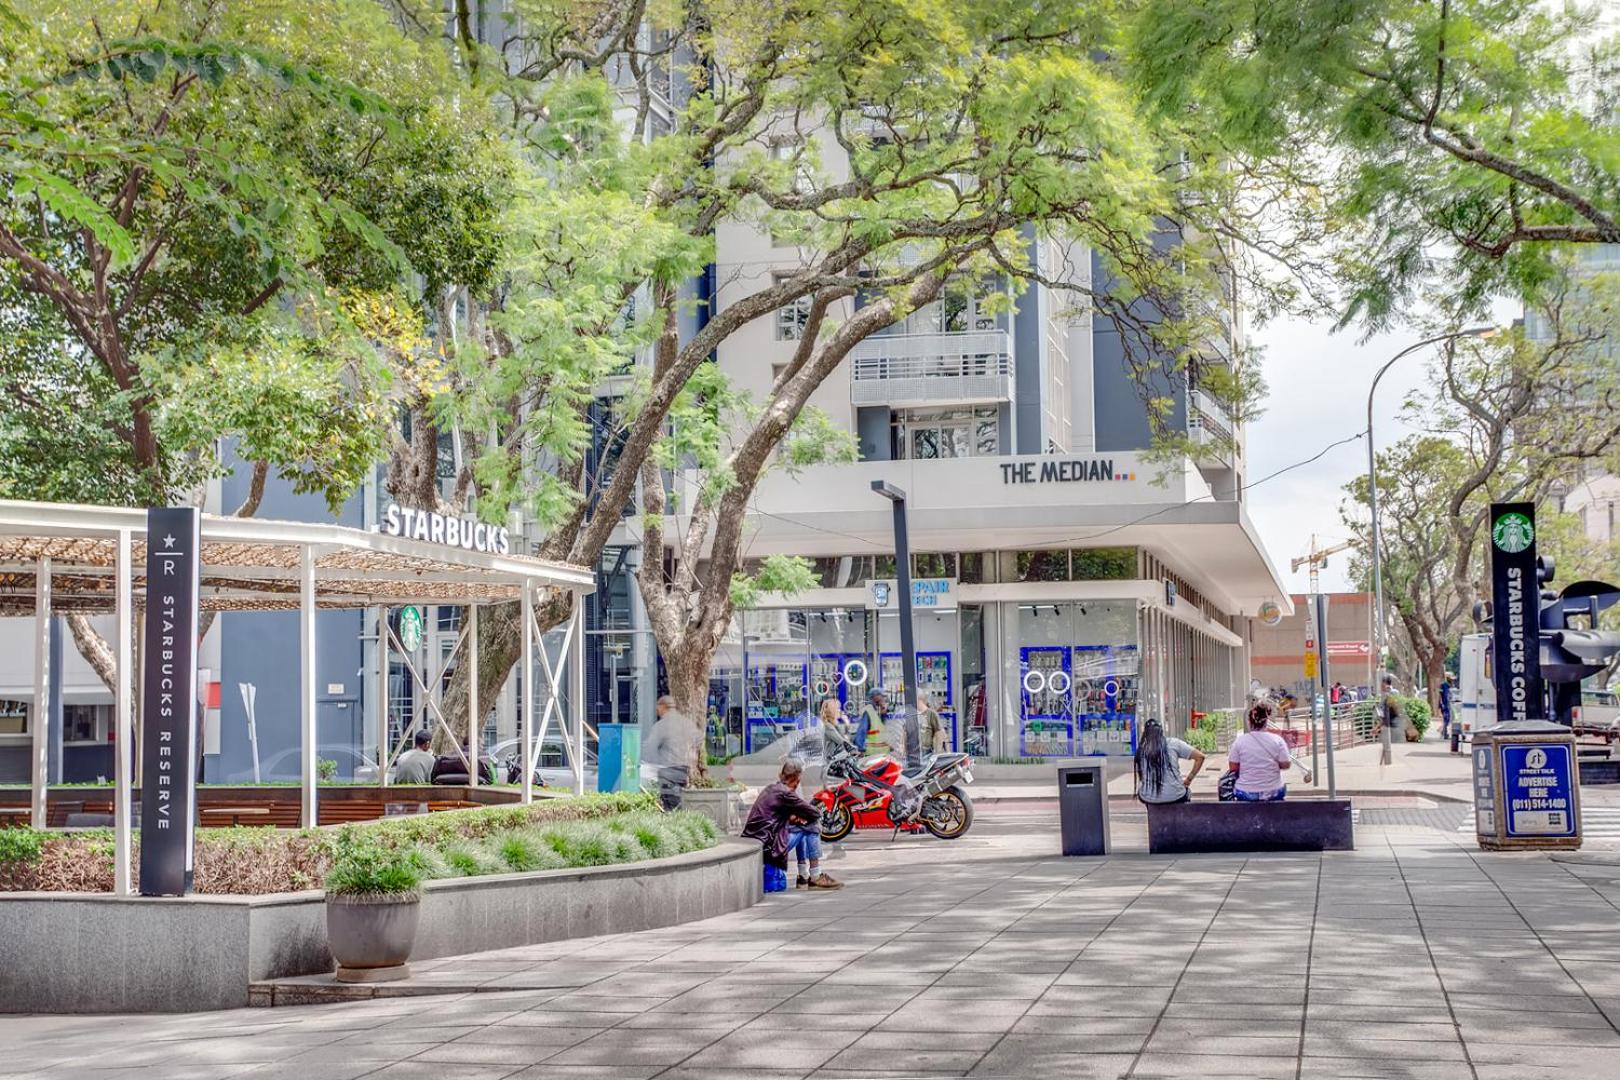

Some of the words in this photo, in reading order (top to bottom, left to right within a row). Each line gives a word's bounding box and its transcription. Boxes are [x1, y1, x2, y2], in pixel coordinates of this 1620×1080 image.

[1000, 462, 1036, 484] THE
[386, 503, 510, 555] STARBUCKS
[163, 561, 174, 575] R
[1508, 567, 1525, 674] STARBUCKS
[161, 596, 174, 717] STARBUCKS
[158, 731, 171, 829] RESERVE
[1518, 776, 1558, 787] ADVERTISE
[1529, 788, 1549, 797] HERE
